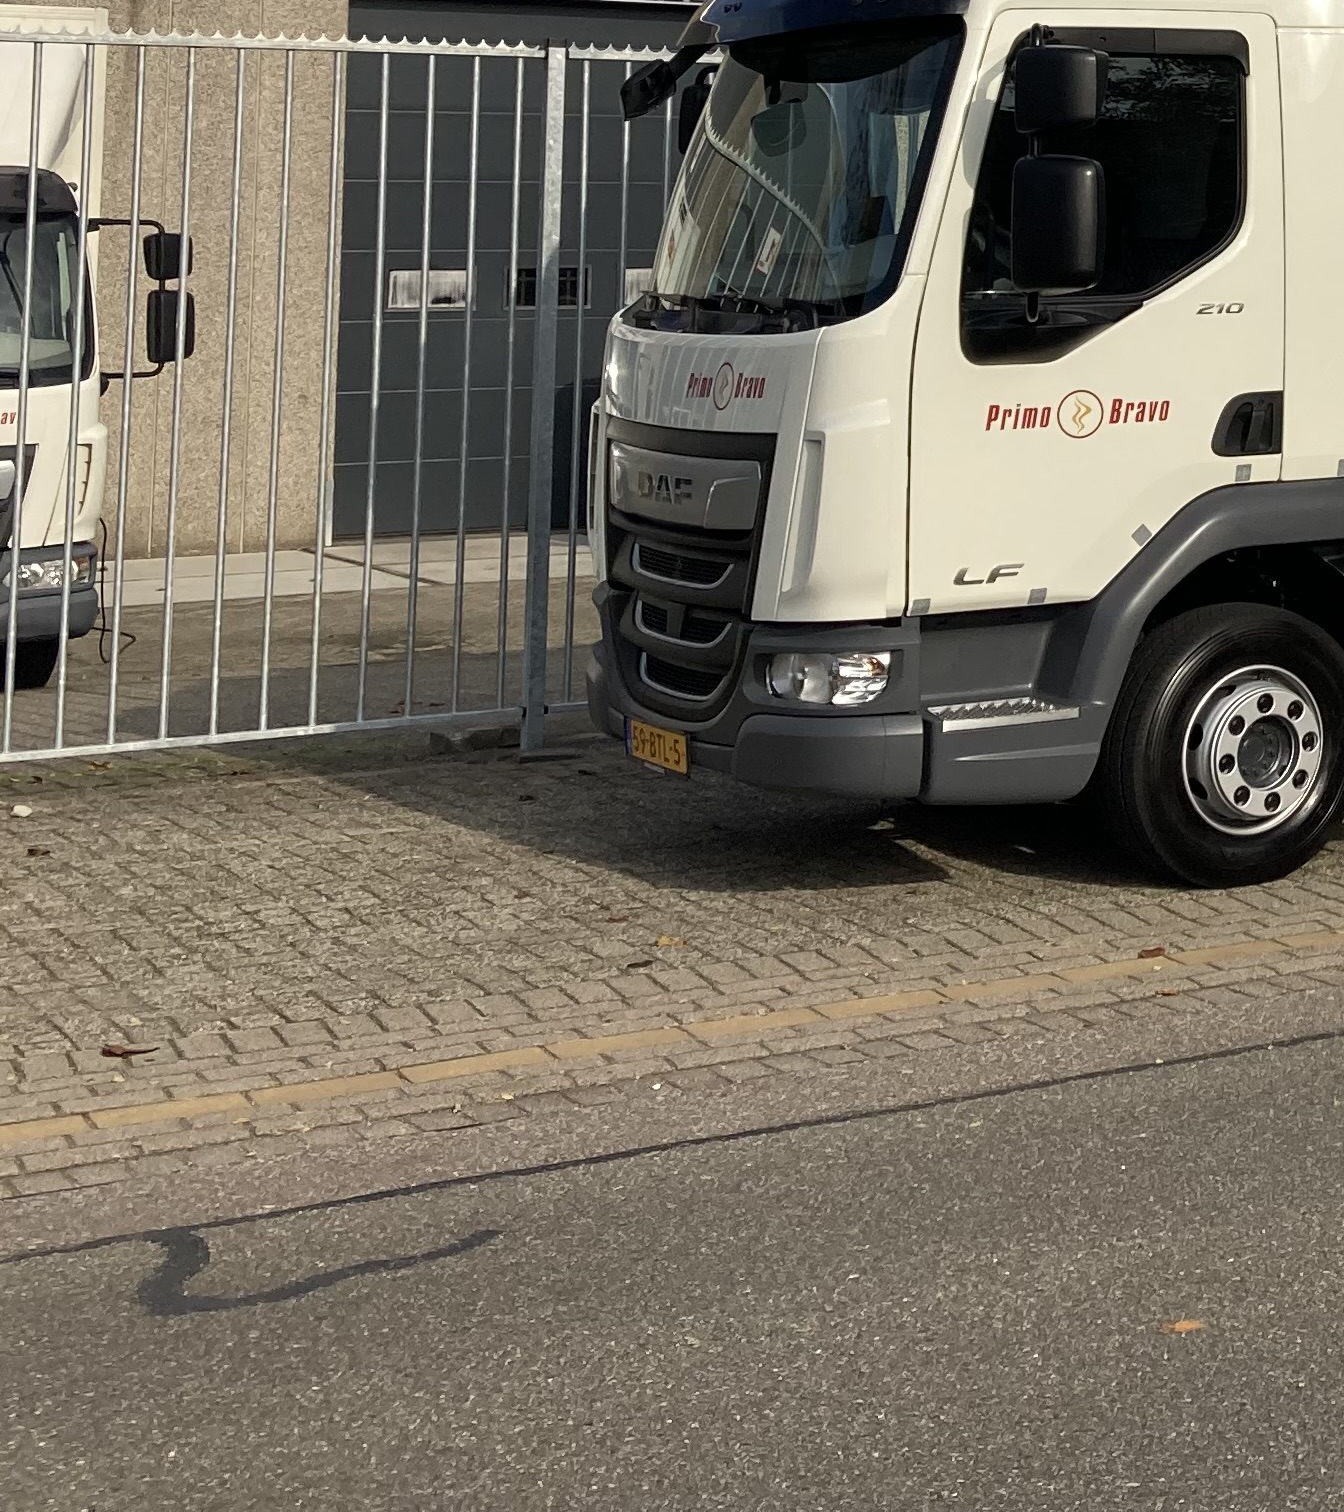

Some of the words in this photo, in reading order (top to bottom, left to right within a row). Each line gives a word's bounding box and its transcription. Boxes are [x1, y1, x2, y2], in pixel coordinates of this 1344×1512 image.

[1196, 302, 1245, 315] 210
[686, 373, 713, 399] Primo
[734, 372, 766, 399] Bravo
[985, 403, 1051, 431] Primo
[1109, 398, 1170, 425] Bravo
[638, 471, 692, 505] DAF
[953, 563, 1025, 585] LF
[633, 725, 681, 766] 59-BTL-5
